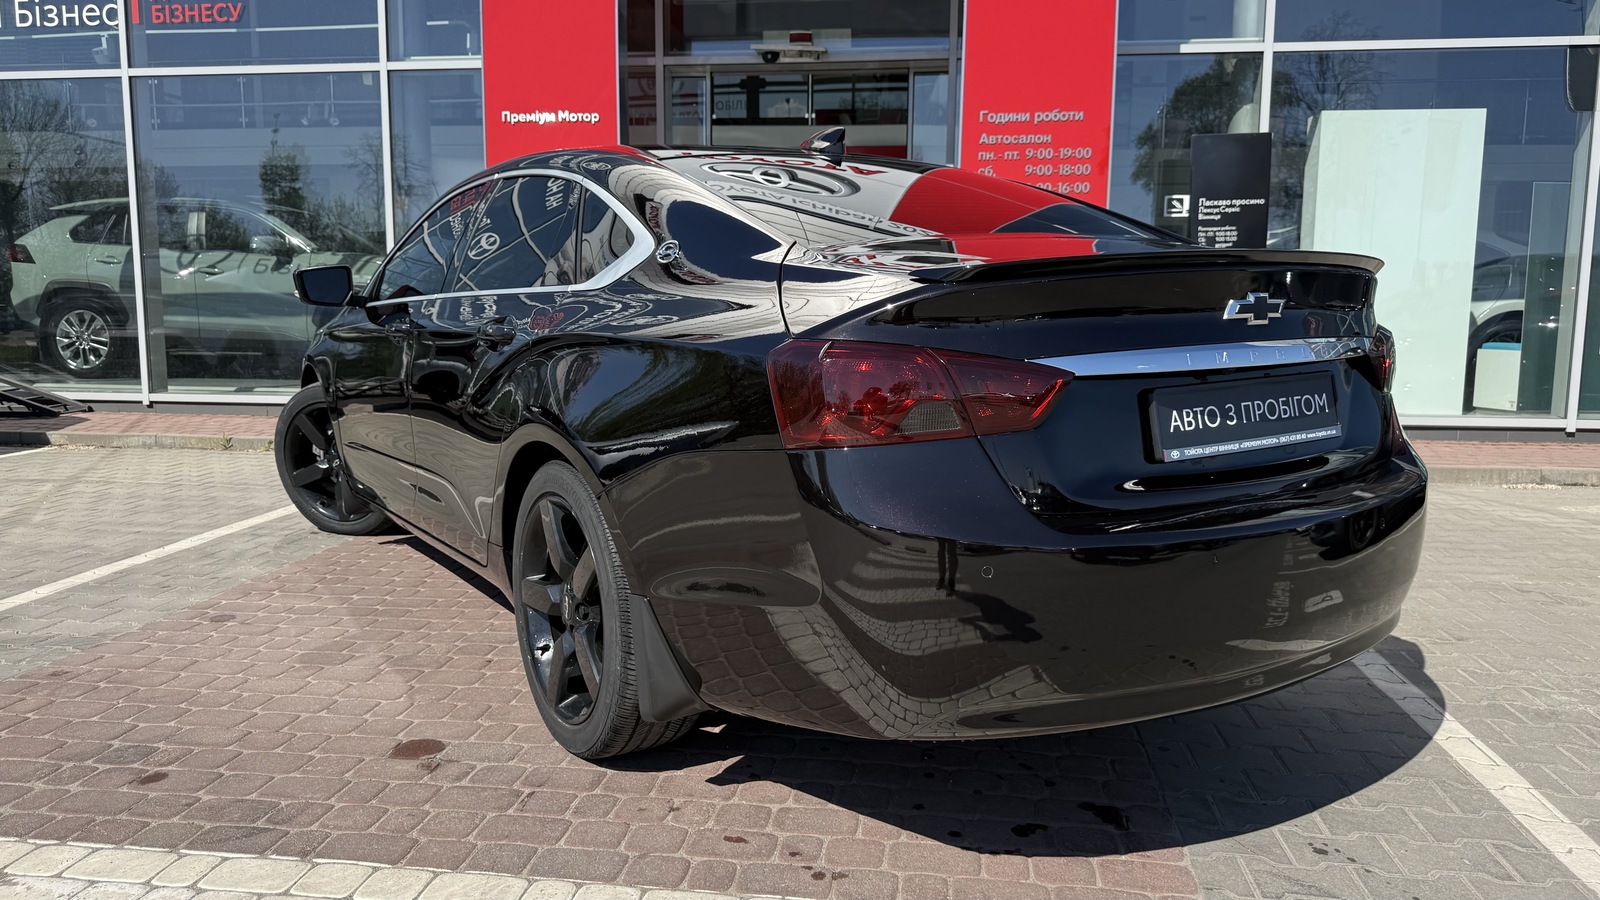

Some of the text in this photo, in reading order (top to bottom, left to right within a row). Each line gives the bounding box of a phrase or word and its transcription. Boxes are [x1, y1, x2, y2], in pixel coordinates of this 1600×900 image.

[152, 3, 243, 24] БІЗНЕСУ
[501, 110, 600, 124] Преміум Мотор
[979, 109, 1084, 124] Години роботи
[978, 133, 1052, 145] Автосалон
[1025, 147, 1093, 159] 9:00-19:00
[1025, 164, 1091, 176] 9:00-18:00
[1170, 405, 1220, 433] АВТО
[1241, 393, 1329, 423] ПРОБІГОМ
